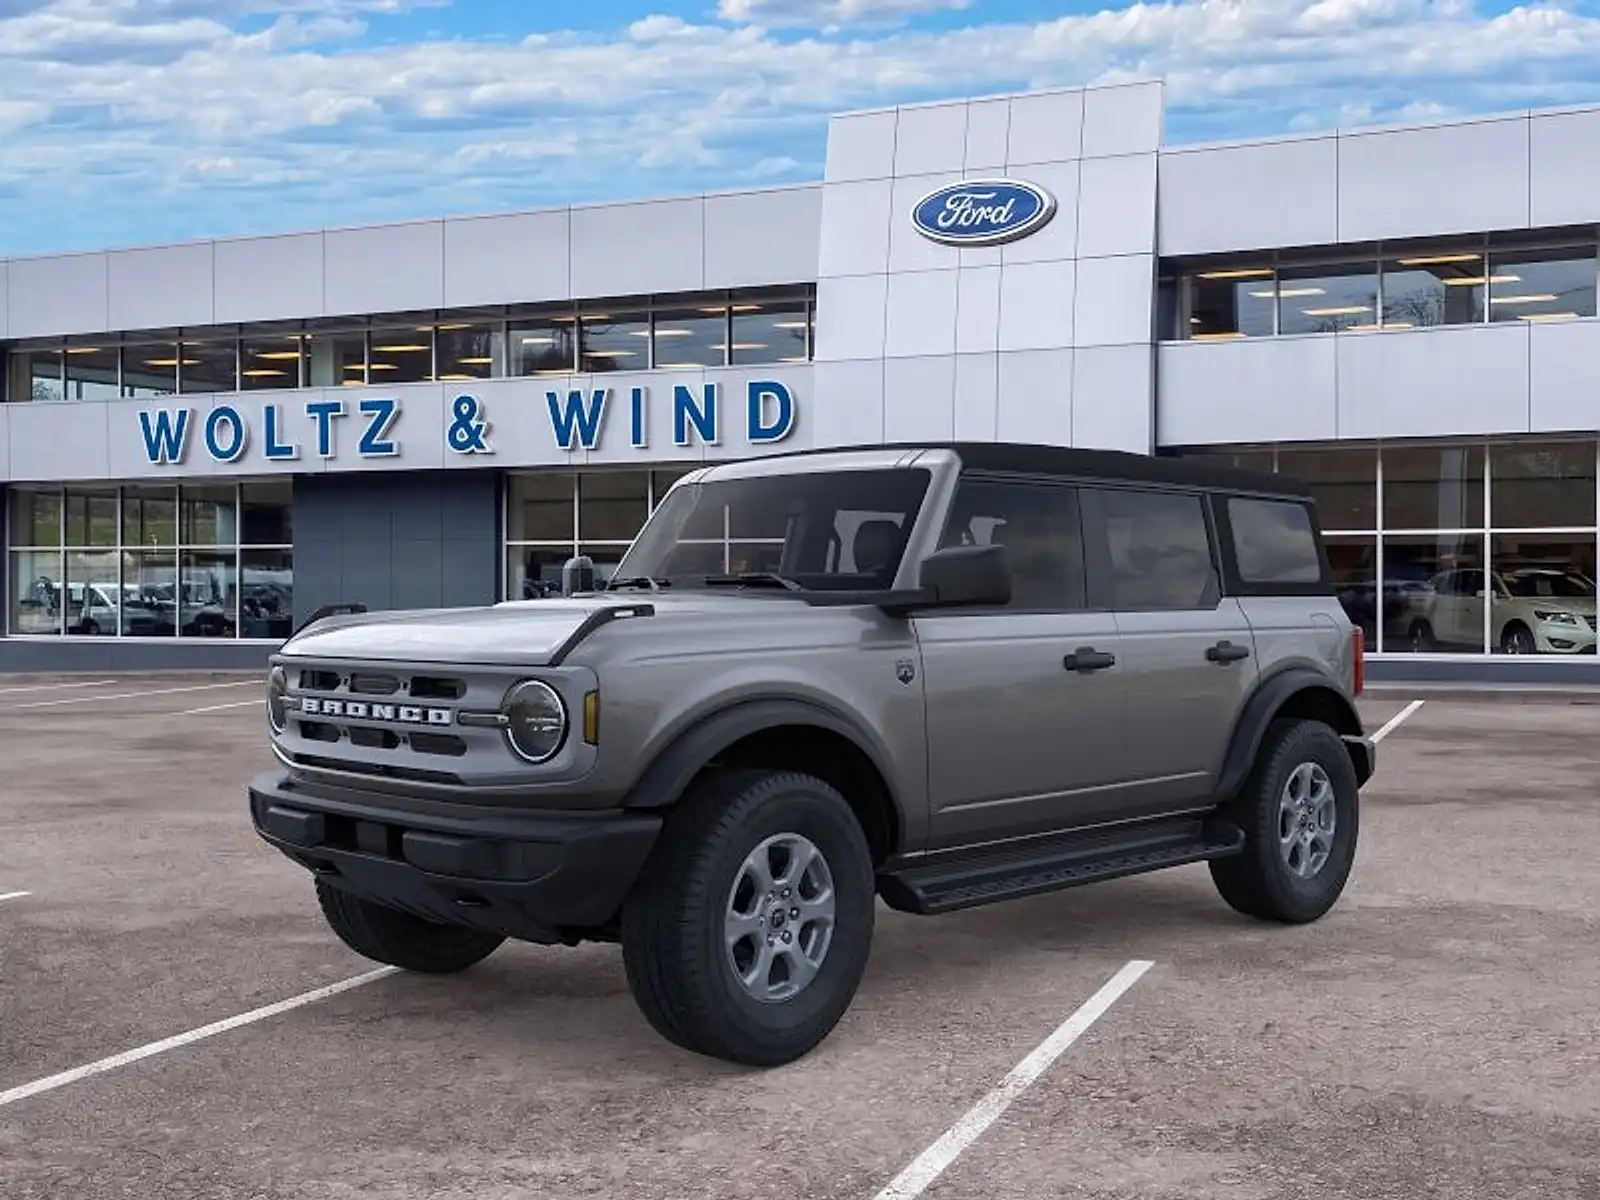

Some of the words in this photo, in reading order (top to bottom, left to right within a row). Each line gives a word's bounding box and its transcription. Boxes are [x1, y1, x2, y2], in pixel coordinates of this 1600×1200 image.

[938, 192, 1015, 227] Ford
[138, 399, 402, 464] WOLTZ
[446, 394, 492, 454] &
[546, 380, 796, 451] WIND
[301, 697, 451, 725] BRONCO
